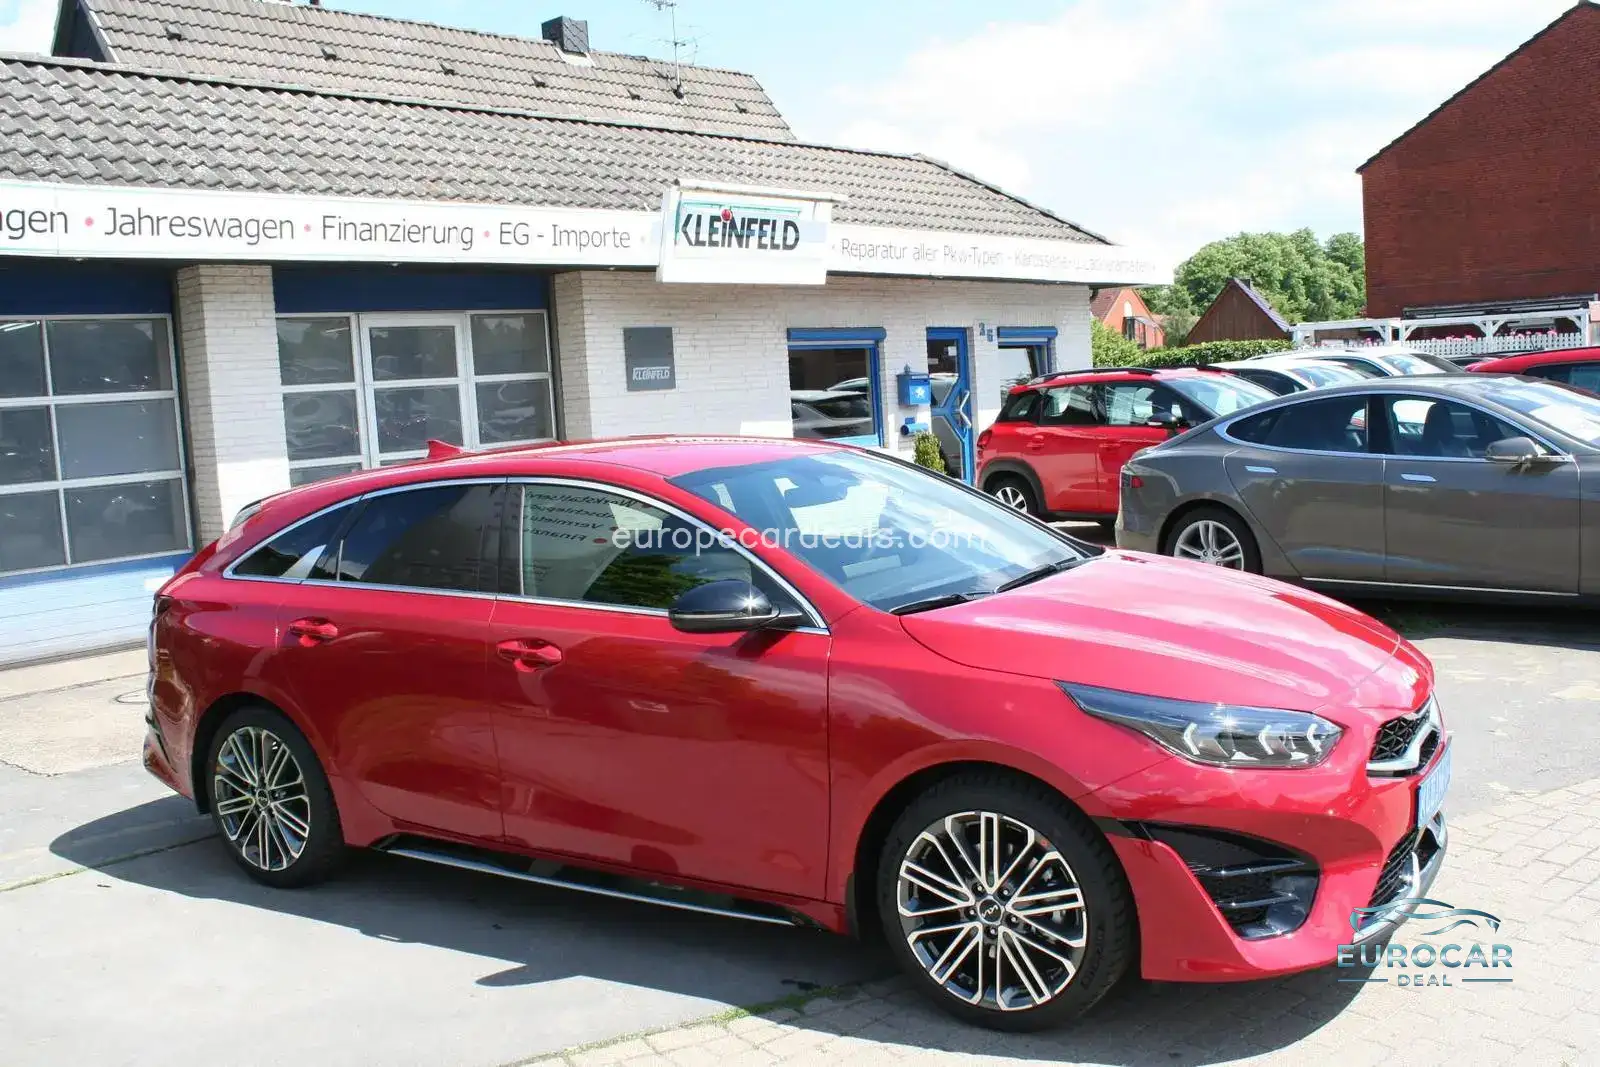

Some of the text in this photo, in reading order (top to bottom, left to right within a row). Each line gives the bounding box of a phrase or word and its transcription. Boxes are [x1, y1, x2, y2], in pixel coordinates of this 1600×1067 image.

[0, 209, 68, 240] gen
[105, 207, 294, 245] Jahreswagen
[322, 215, 473, 251] Finanzierung
[500, 222, 529, 246] EG
[552, 224, 630, 252] Importe
[841, 238, 908, 261] Reparatur
[912, 243, 937, 261] aller
[632, 366, 670, 381] KLEINFELD
